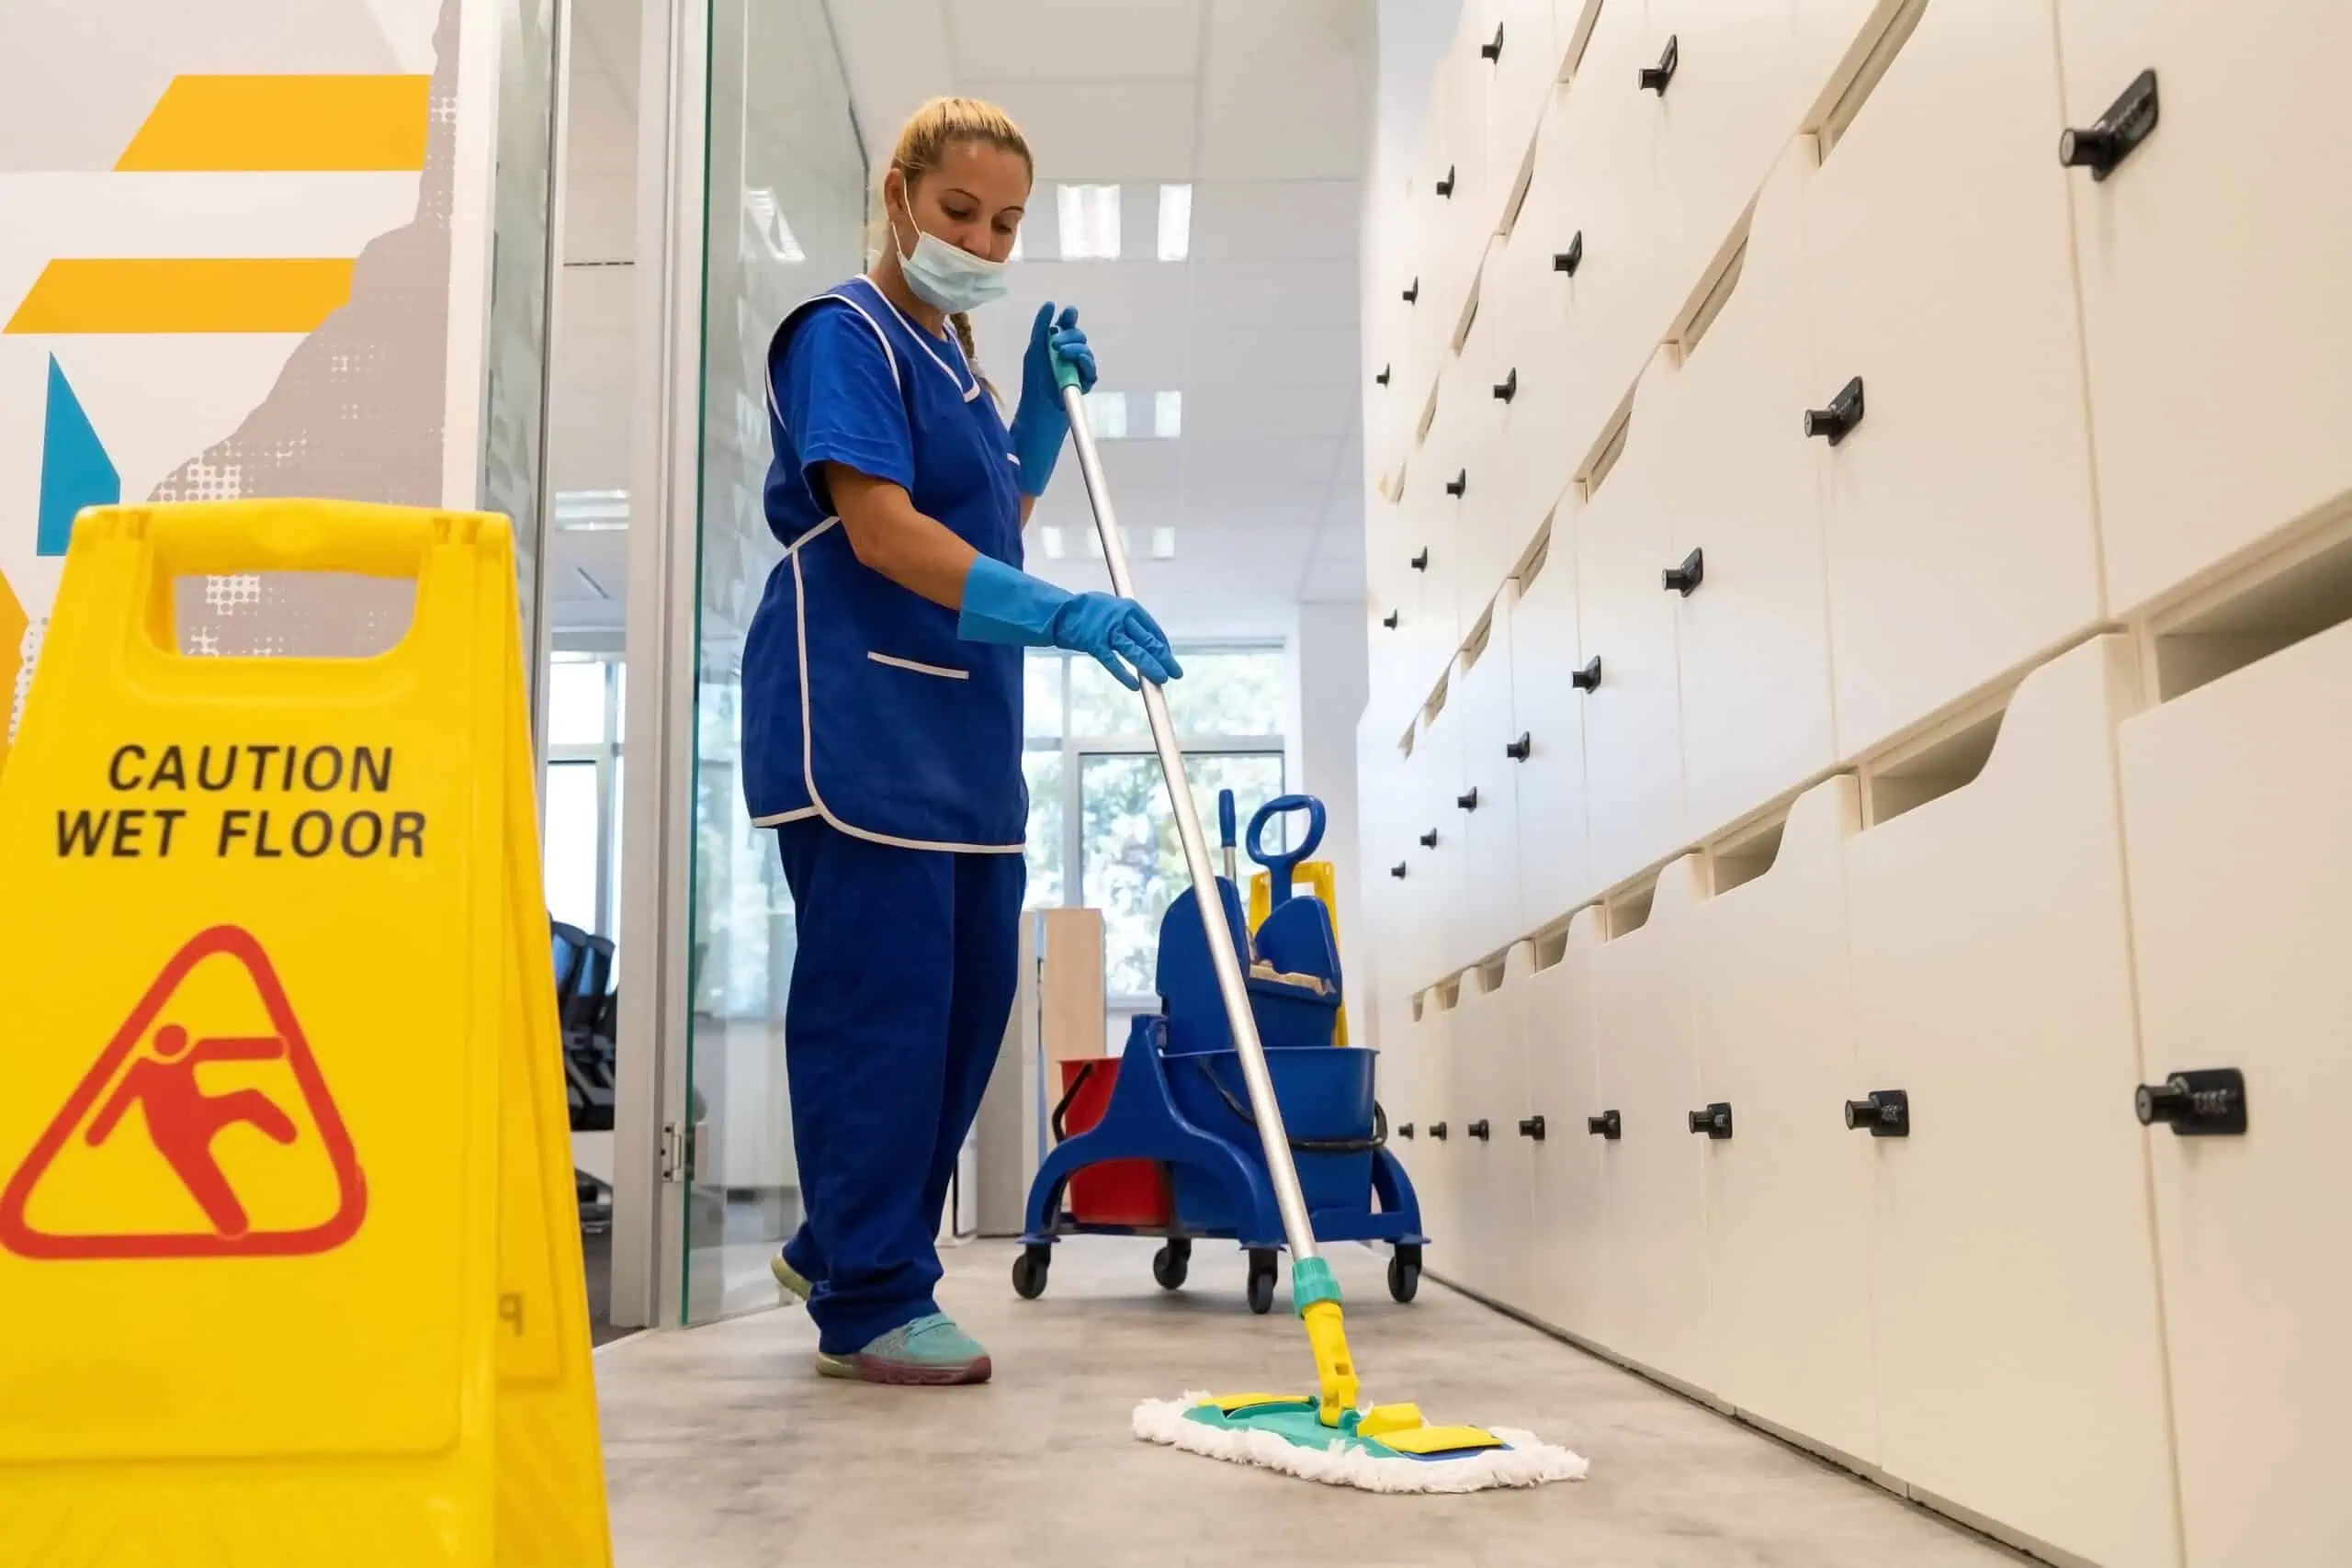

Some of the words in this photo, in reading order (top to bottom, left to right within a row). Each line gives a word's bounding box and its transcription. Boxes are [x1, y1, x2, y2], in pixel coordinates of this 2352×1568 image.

[108, 744, 392, 793] CAUTION
[56, 809, 187, 858] WET
[217, 809, 427, 859] FLOOR
